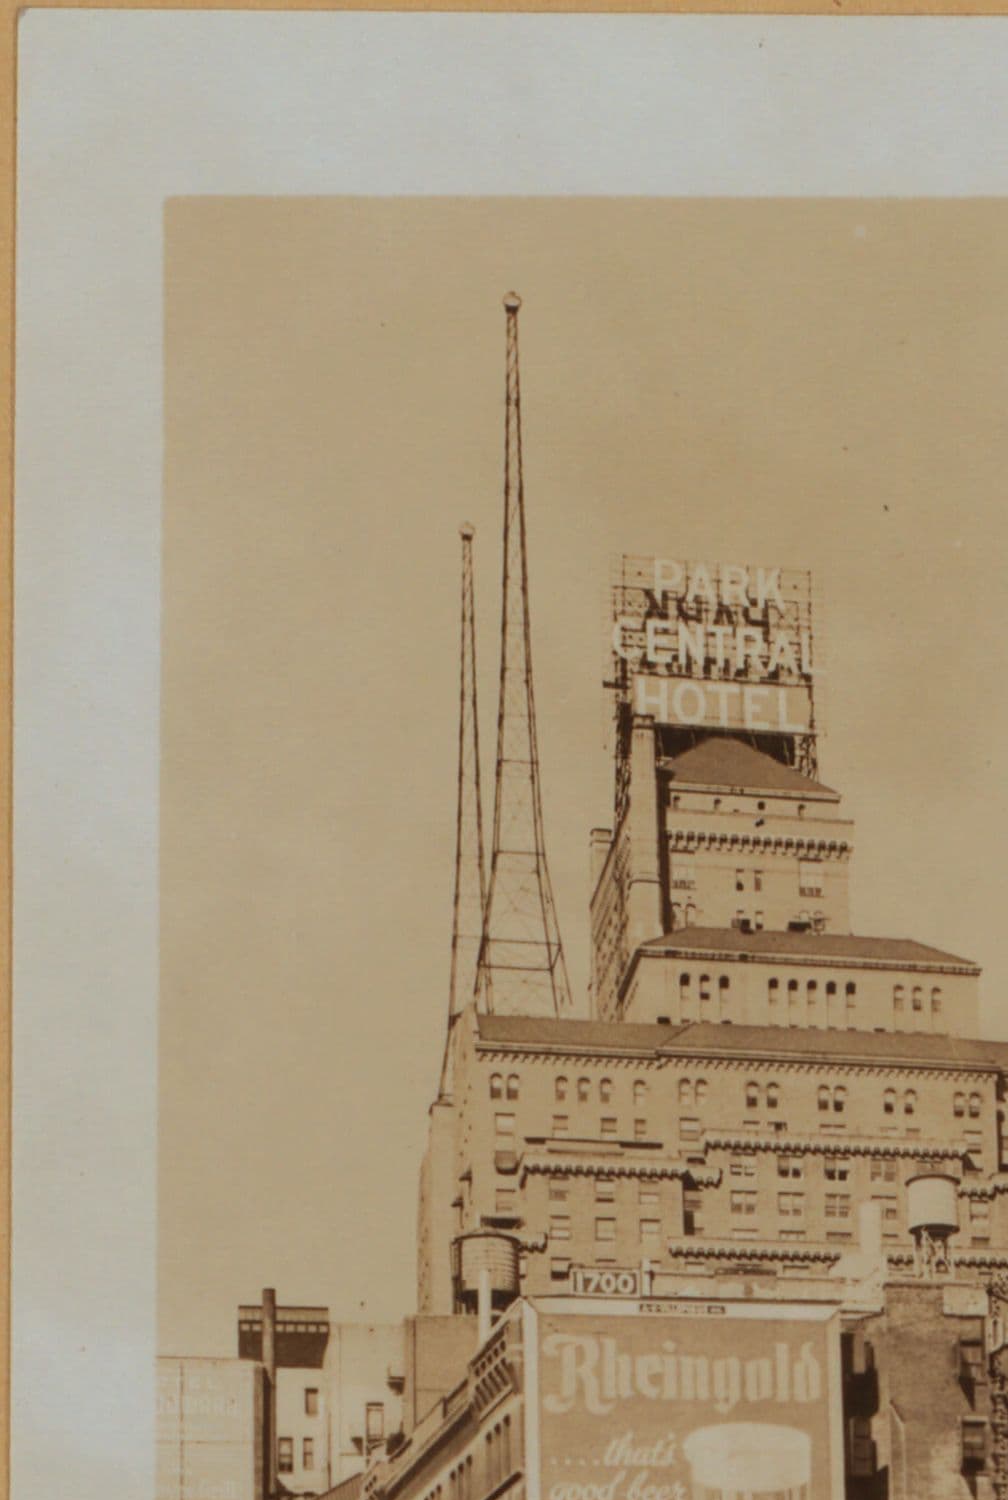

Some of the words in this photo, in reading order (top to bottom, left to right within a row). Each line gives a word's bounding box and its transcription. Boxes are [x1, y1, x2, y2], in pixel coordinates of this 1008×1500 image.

[654, 559, 787, 611] PARK
[612, 617, 812, 674] CENTRAL
[635, 677, 806, 731] HOTEL
[575, 1271, 635, 1294] 1700
[542, 1333, 823, 1414] Rheingold
